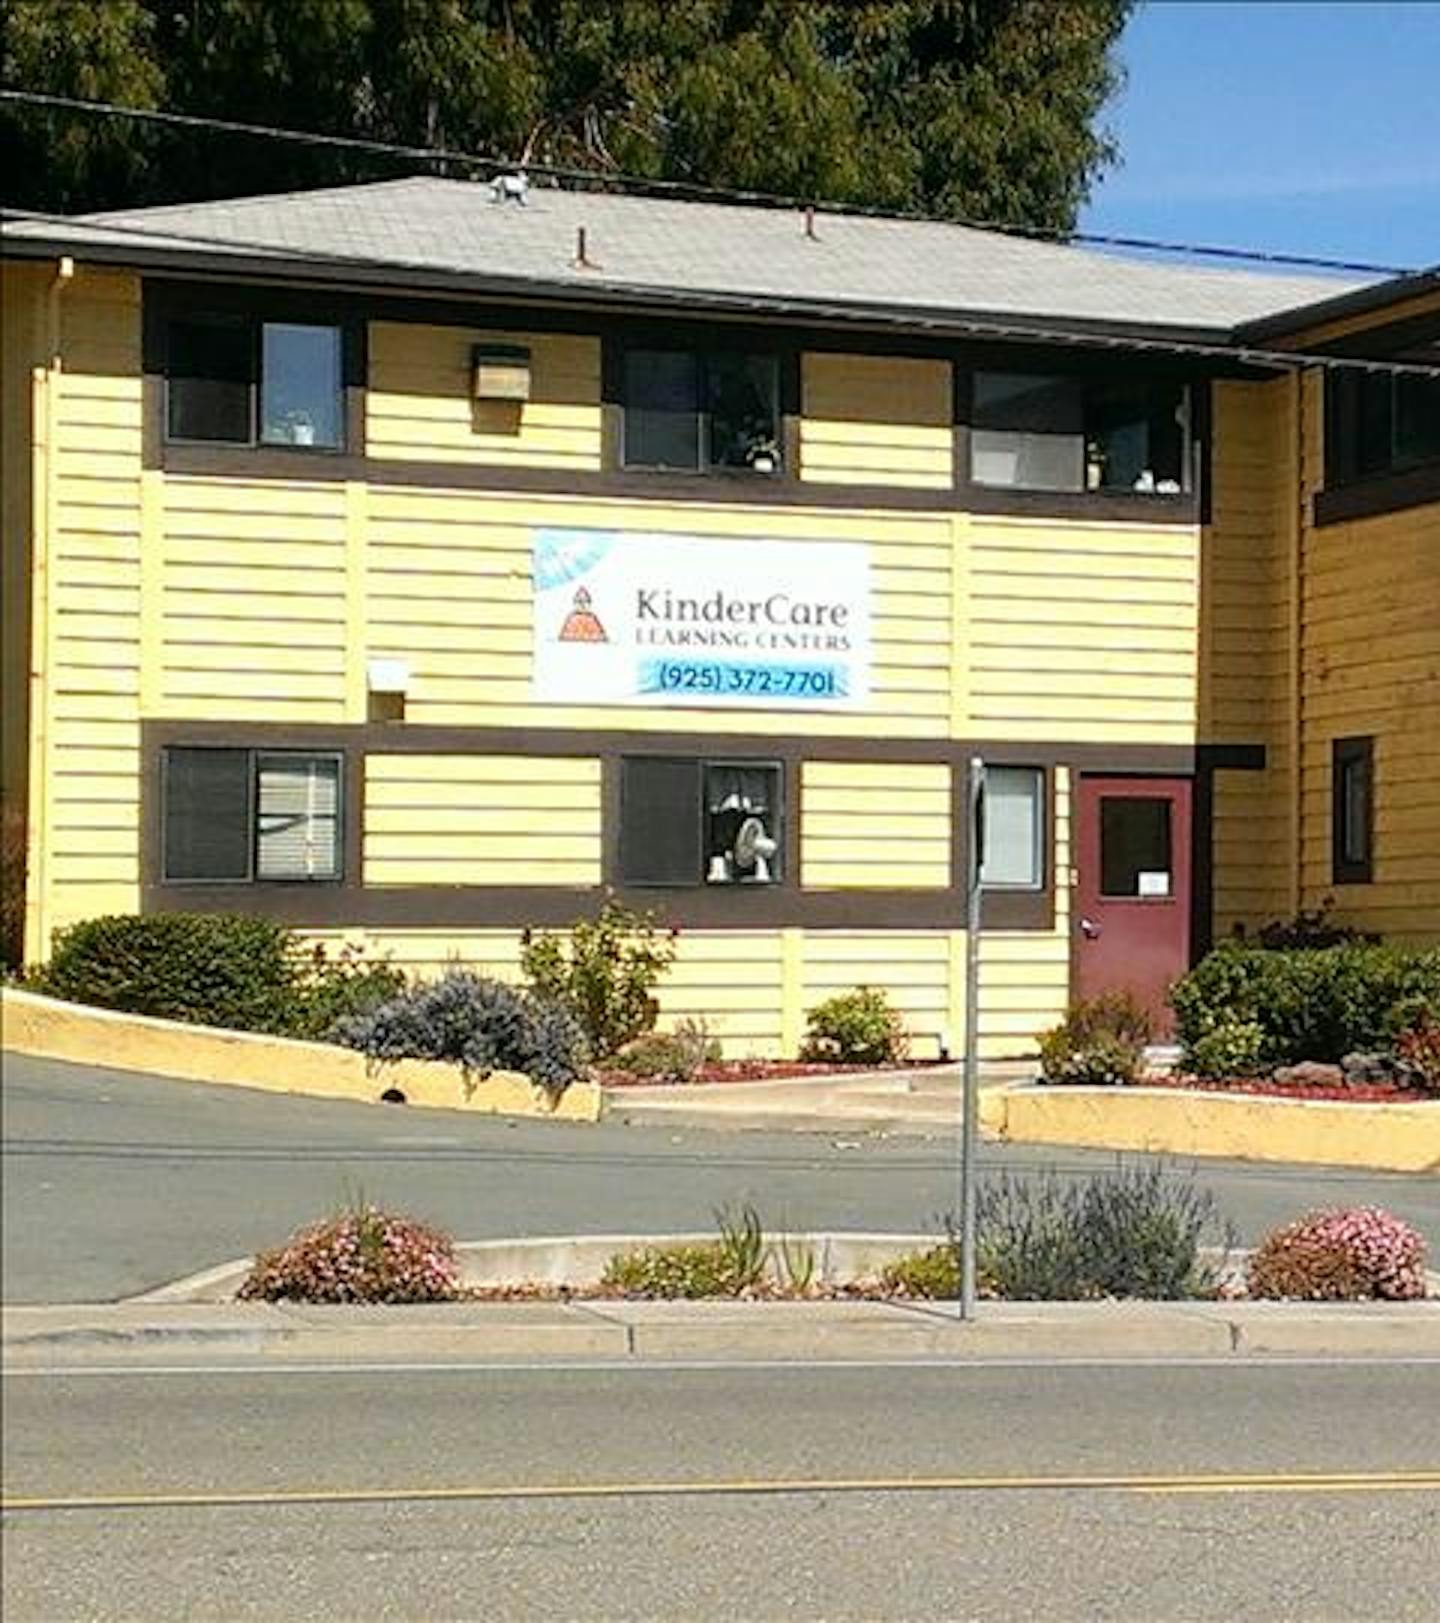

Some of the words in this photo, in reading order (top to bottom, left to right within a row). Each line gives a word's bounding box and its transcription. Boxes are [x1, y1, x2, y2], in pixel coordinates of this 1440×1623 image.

[636, 589, 849, 627] KinderCare
[636, 626, 749, 648] LEARNING
[755, 632, 851, 651] CENTERS
[659, 663, 721, 690] (925)
[728, 667, 835, 693] 372-7701
